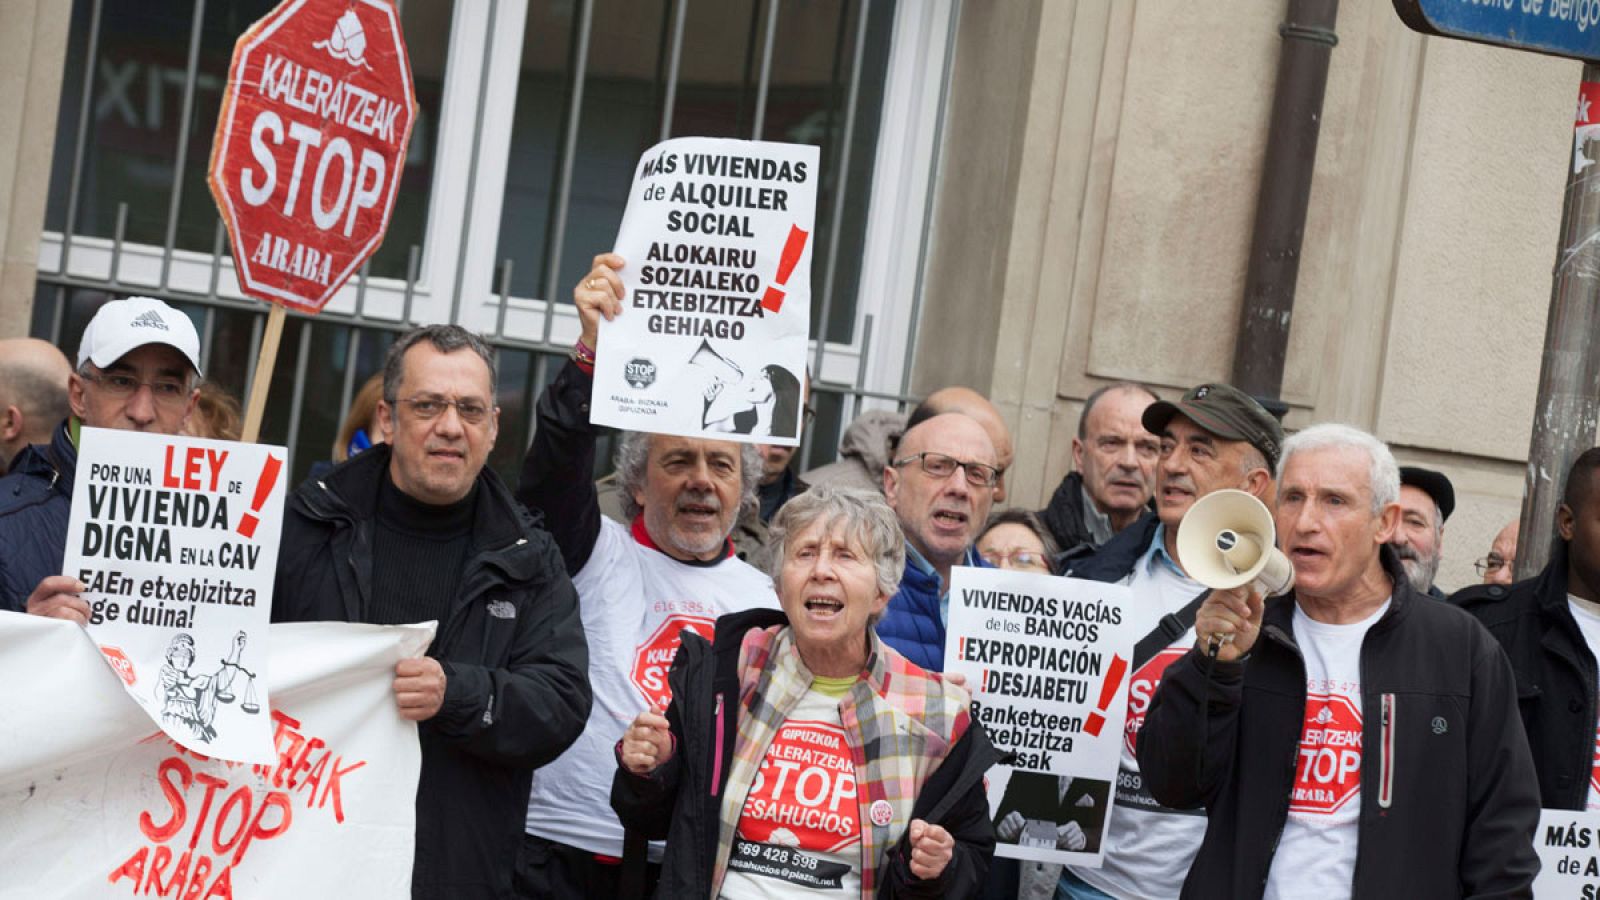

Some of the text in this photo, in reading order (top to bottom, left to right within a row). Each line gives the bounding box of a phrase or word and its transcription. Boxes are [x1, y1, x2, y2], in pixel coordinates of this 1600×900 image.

[259, 53, 402, 144] KALERATZEAK
[240, 110, 386, 237] STOP
[640, 150, 808, 184] MÁS VIVIENDAS
[643, 181, 788, 212] de ALQUILER
[667, 210, 755, 238] SOCIAL
[252, 232, 333, 286] ARABA
[646, 242, 757, 269] ALOKAIRU
[640, 265, 760, 293] SOZIALEKO
[632, 288, 765, 318] ETXEBIZITZA
[130, 319, 169, 332] adidas
[647, 314, 745, 341] GEHIAGO
[627, 363, 654, 376] STOP
[90, 444, 243, 494] POR UNA LEY DE
[88, 484, 229, 531] VIVIENDA
[82, 522, 261, 570] DIGNA EN LA CAV
[79, 568, 257, 608] EAEn etxebizitza
[88, 598, 196, 629] ge duina!
[961, 588, 1122, 625] VIVIENDAS VACÍAS
[985, 616, 1099, 643] de los BANCOS
[646, 648, 678, 665] KALE
[970, 700, 1083, 733] Banketxeen
[782, 728, 840, 749] GIPUZKOA
[765, 743, 855, 773] ALERATZEAK
[1299, 747, 1361, 785] TOP
[139, 756, 293, 868] STOP
[741, 796, 854, 837] ESAHUCIOS
[1545, 821, 1592, 849] MÁS
[737, 842, 819, 870] 669 428 598
[1557, 855, 1581, 875] de
[108, 845, 233, 900] ARABA
